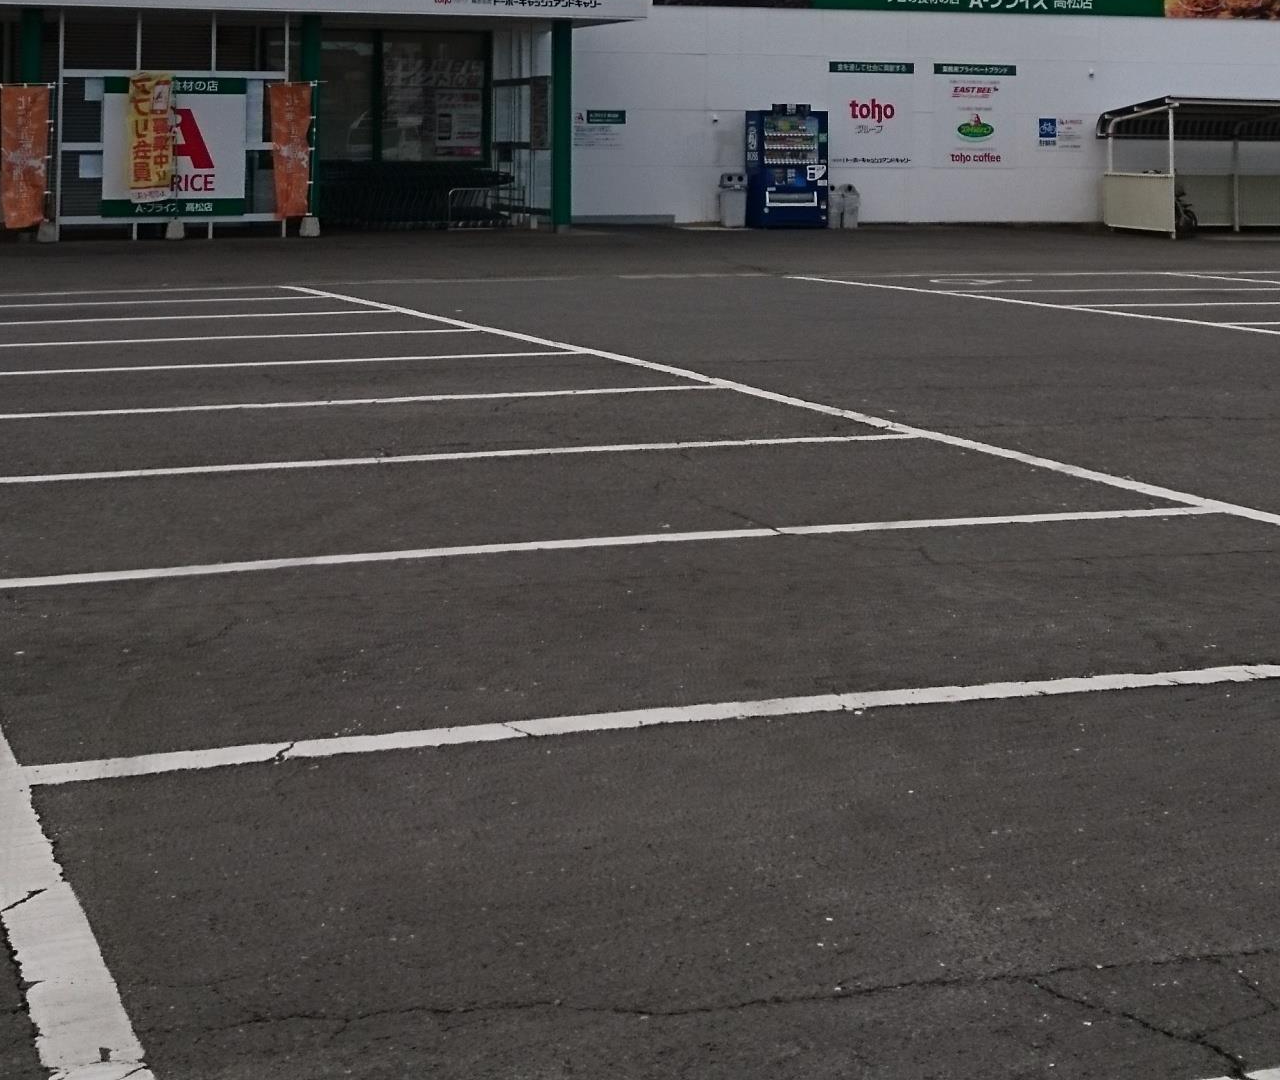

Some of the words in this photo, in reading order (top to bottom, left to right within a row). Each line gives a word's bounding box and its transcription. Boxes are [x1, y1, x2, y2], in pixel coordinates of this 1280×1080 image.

[849, 99, 895, 123] toho
[950, 153, 971, 164] toho
[973, 153, 1001, 162] coffee
[185, 202, 213, 212] 高松店
